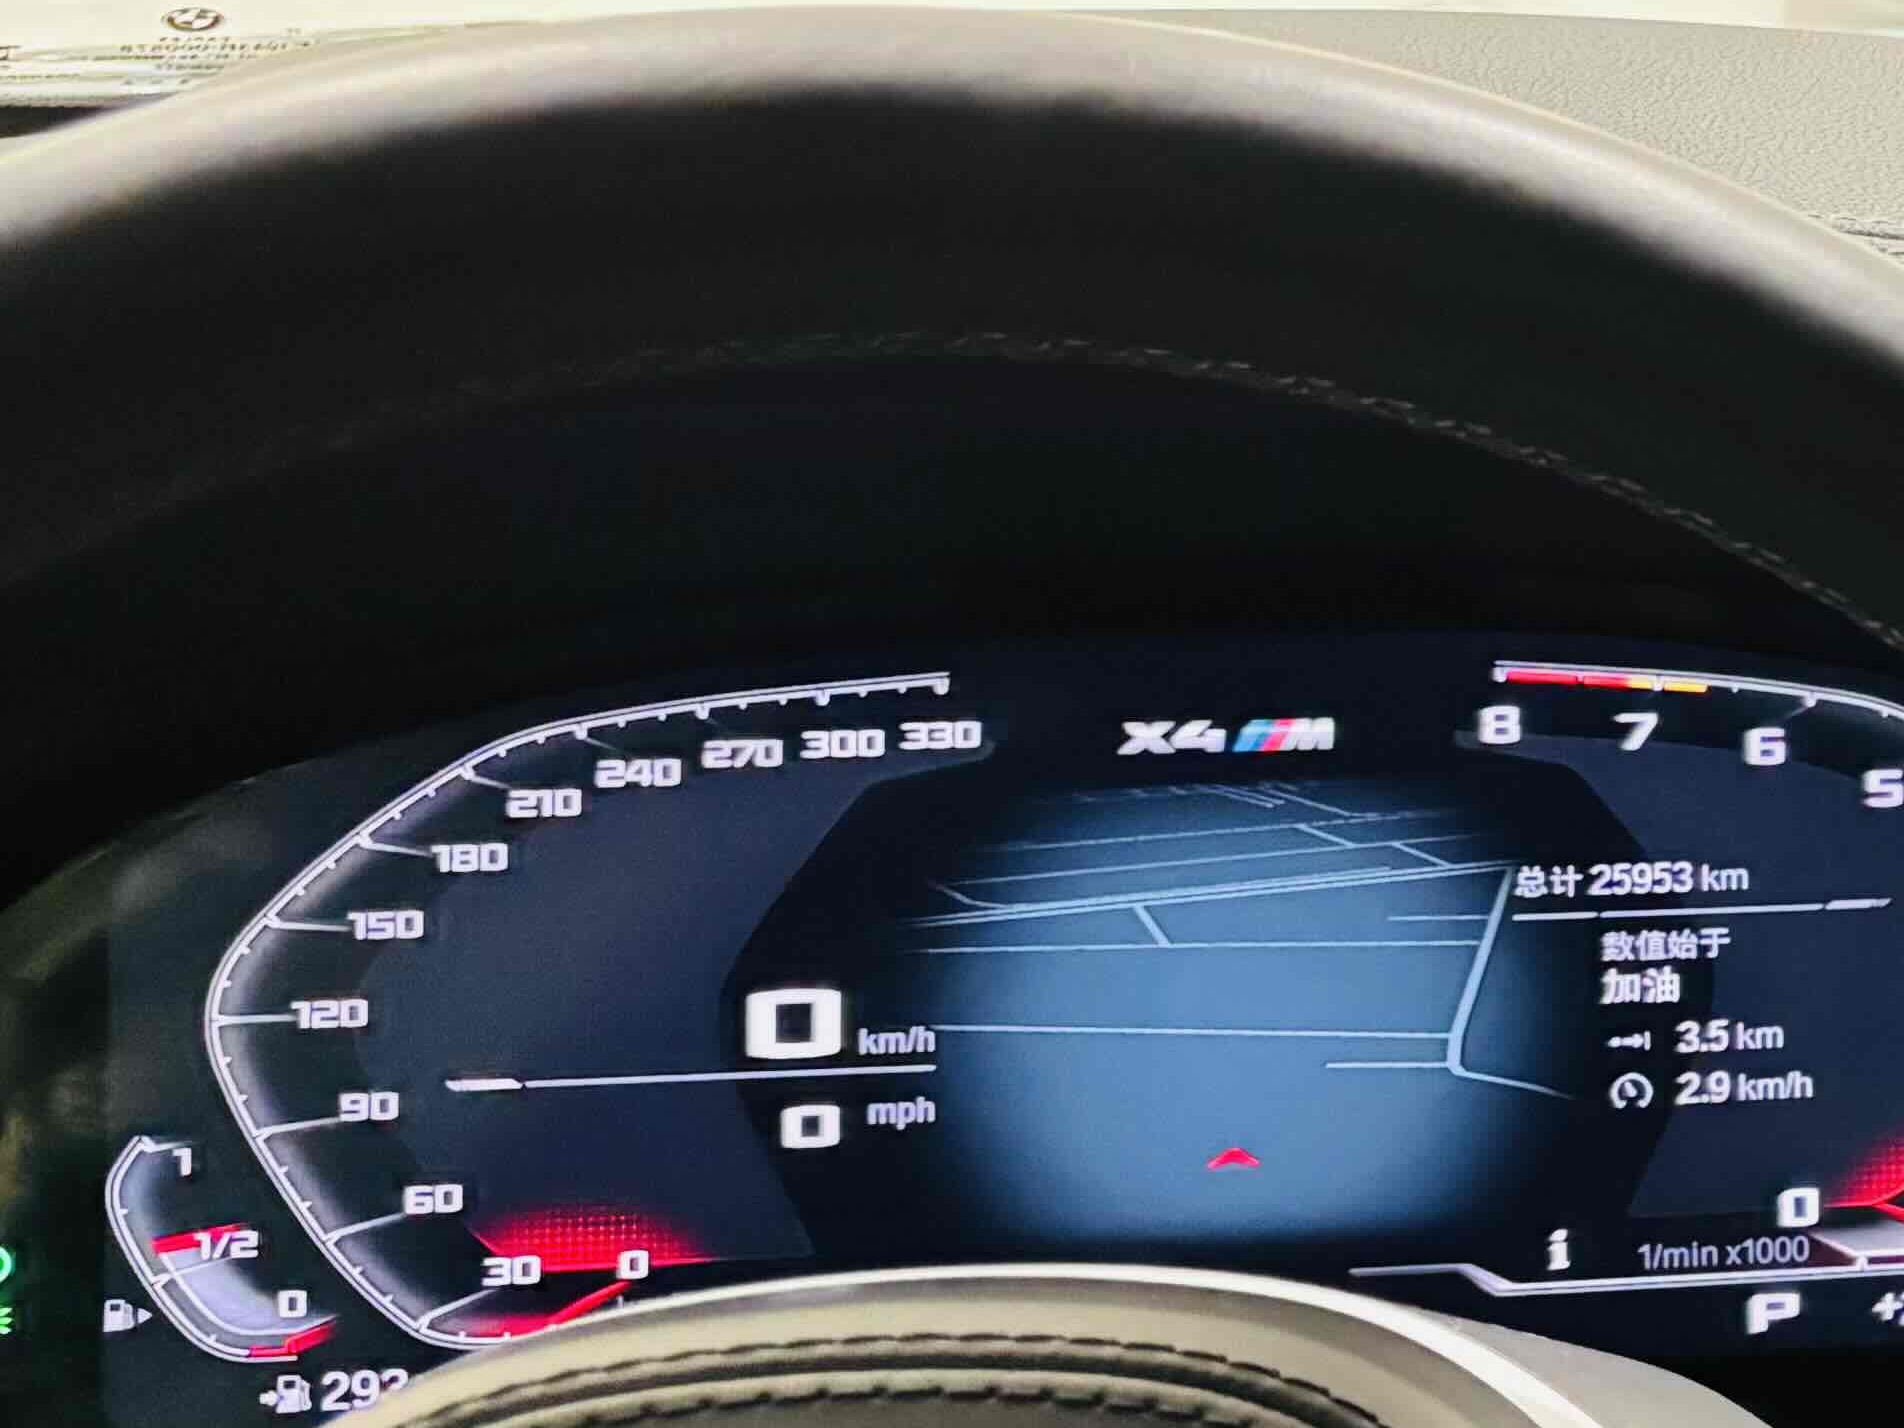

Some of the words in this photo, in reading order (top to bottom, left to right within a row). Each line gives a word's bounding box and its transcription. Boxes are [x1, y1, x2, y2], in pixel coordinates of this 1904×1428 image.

[899, 720, 982, 751] 330
[1117, 719, 1227, 756] X4
[1479, 705, 1521, 745] 8
[1616, 712, 1658, 751] 7
[701, 737, 784, 770] 270
[800, 728, 885, 760] 300
[1744, 728, 1787, 767] 6
[594, 757, 682, 788] 240
[1861, 768, 1904, 808] 5
[505, 788, 582, 819] 210
[430, 842, 509, 873] 180
[1514, 864, 1582, 899] 总计
[1587, 860, 1694, 897] 25953
[1700, 860, 1750, 893] km
[347, 909, 425, 942] 150
[1600, 928, 1731, 960] 数值始于
[1600, 968, 1682, 1005] 加油
[289, 998, 369, 1030] 120
[745, 988, 842, 1060] 0
[857, 1026, 937, 1059] km/h
[1675, 1021, 1729, 1053] 3.5
[1736, 1023, 1785, 1049] km
[1674, 1071, 1731, 1106] 2.9
[1736, 1071, 1814, 1103] km/h
[338, 1091, 400, 1122] 90
[780, 1104, 840, 1149] 0
[866, 1097, 937, 1128] mph
[171, 1147, 194, 1176] 1
[402, 1183, 464, 1214] 60
[1778, 1189, 1820, 1228] 0
[195, 1230, 259, 1260] 1/2
[1638, 1248, 1719, 1269] 1/min
[1726, 1236, 1810, 1264] x1000
[481, 1255, 541, 1287] 30
[616, 1250, 650, 1279] 0
[277, 1291, 307, 1317] 0
[1747, 1293, 1801, 1334] P
